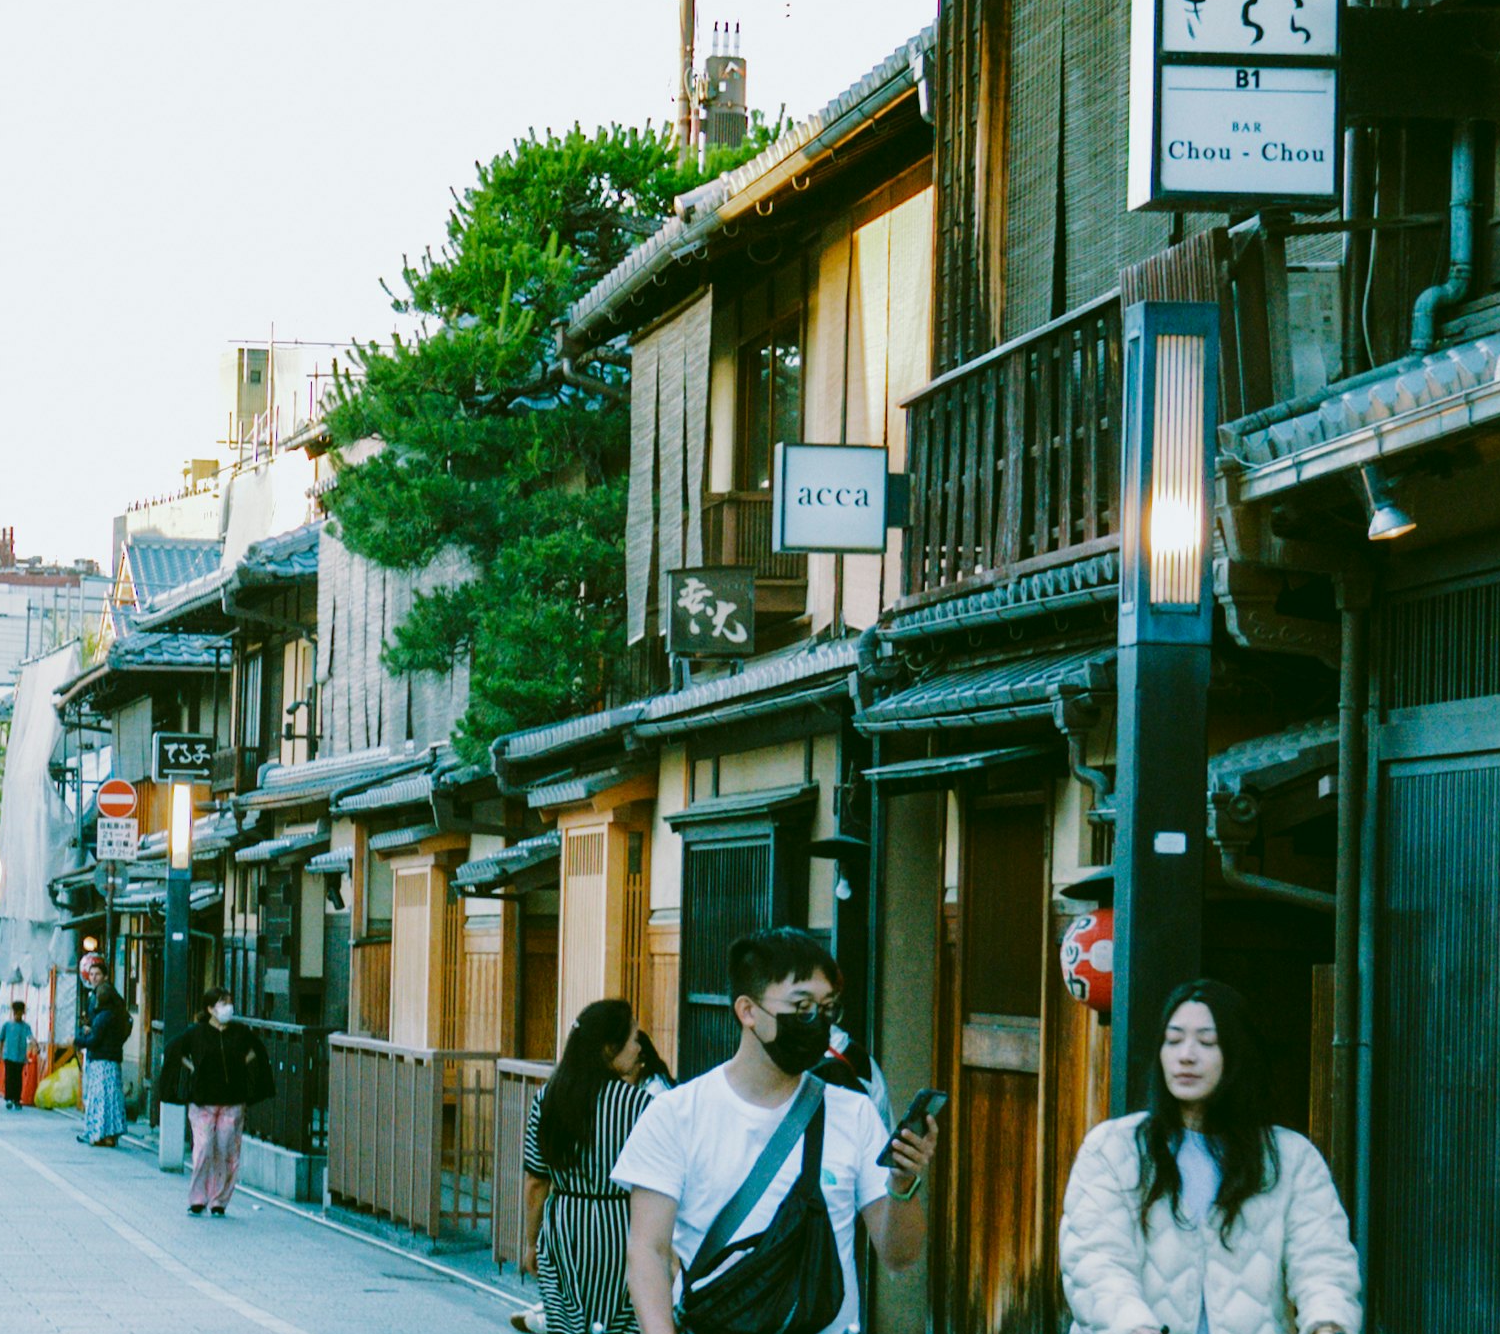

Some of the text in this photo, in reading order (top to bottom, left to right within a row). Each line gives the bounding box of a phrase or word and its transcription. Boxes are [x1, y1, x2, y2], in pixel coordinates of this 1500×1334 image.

[1236, 69, 1260, 88] B1
[1232, 122, 1262, 133] BAR
[1168, 140, 1231, 161] Chou
[1261, 142, 1325, 163] Chou
[798, 487, 870, 507] acca
